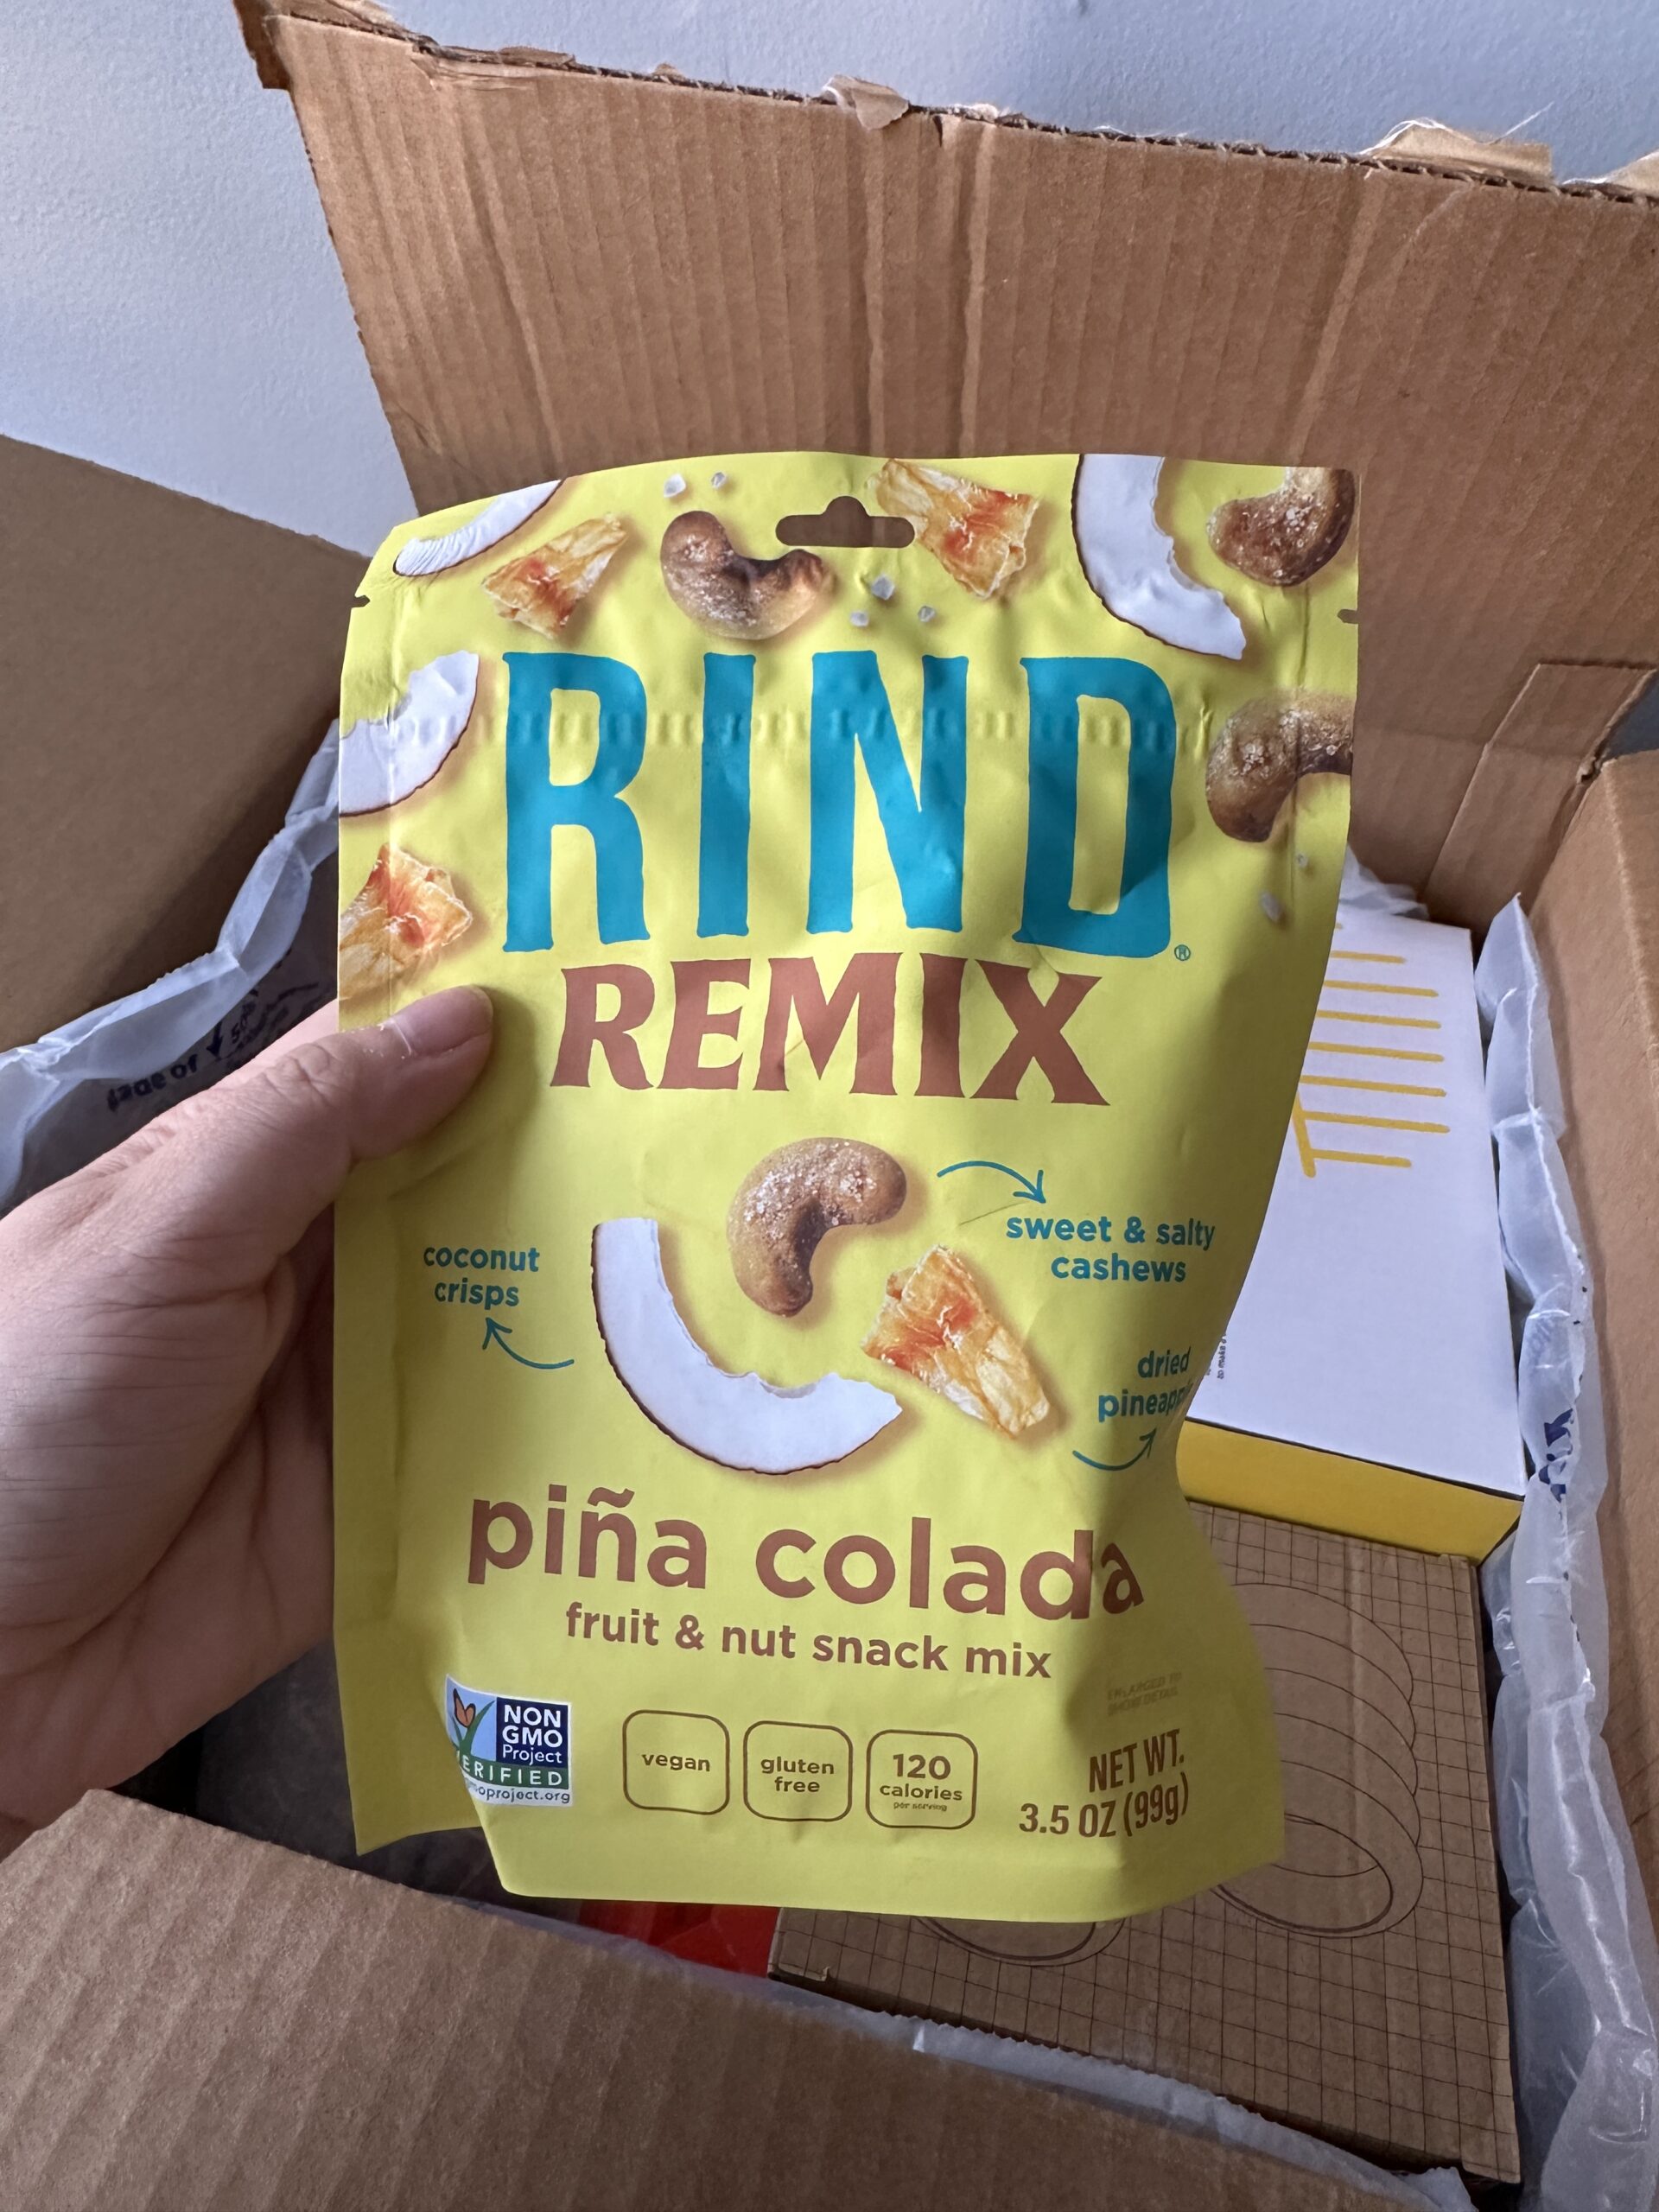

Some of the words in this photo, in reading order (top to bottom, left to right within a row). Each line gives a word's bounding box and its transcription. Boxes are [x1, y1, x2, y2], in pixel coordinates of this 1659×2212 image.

[503, 650, 1178, 957] RIND
[550, 952, 1111, 1106] REMIX
[1006, 1216, 1112, 1243] sweet
[1123, 1216, 1146, 1244] &
[1156, 1217, 1216, 1251] salty
[423, 1246, 541, 1273] coconut
[1051, 1252, 1187, 1282] cashews
[434, 1276, 520, 1311] crisps
[1137, 1345, 1192, 1379] dried
[467, 1484, 707, 1591] piña
[754, 1517, 1145, 1621] colada
[565, 1600, 660, 1648] fruit
[674, 1612, 706, 1651] &
[721, 1625, 798, 1659] nut
[812, 1630, 948, 1673] snack
[964, 1643, 1052, 1679] mix
[504, 1704, 561, 1728] NON
[502, 1725, 563, 1748] GMO
[502, 1744, 563, 1765] Project
[641, 1753, 711, 1773] vegan
[760, 1756, 836, 1776] gluten
[893, 1753, 952, 1781] 120
[1089, 1742, 1138, 1793] NET
[1143, 1728, 1185, 1777] WT.
[774, 1776, 821, 1794] free
[879, 1783, 963, 1802] calories
[1019, 1802, 1070, 1835] 3.5
[1078, 1800, 1117, 1838] OZ
[1123, 1771, 1189, 1837] (99g)
